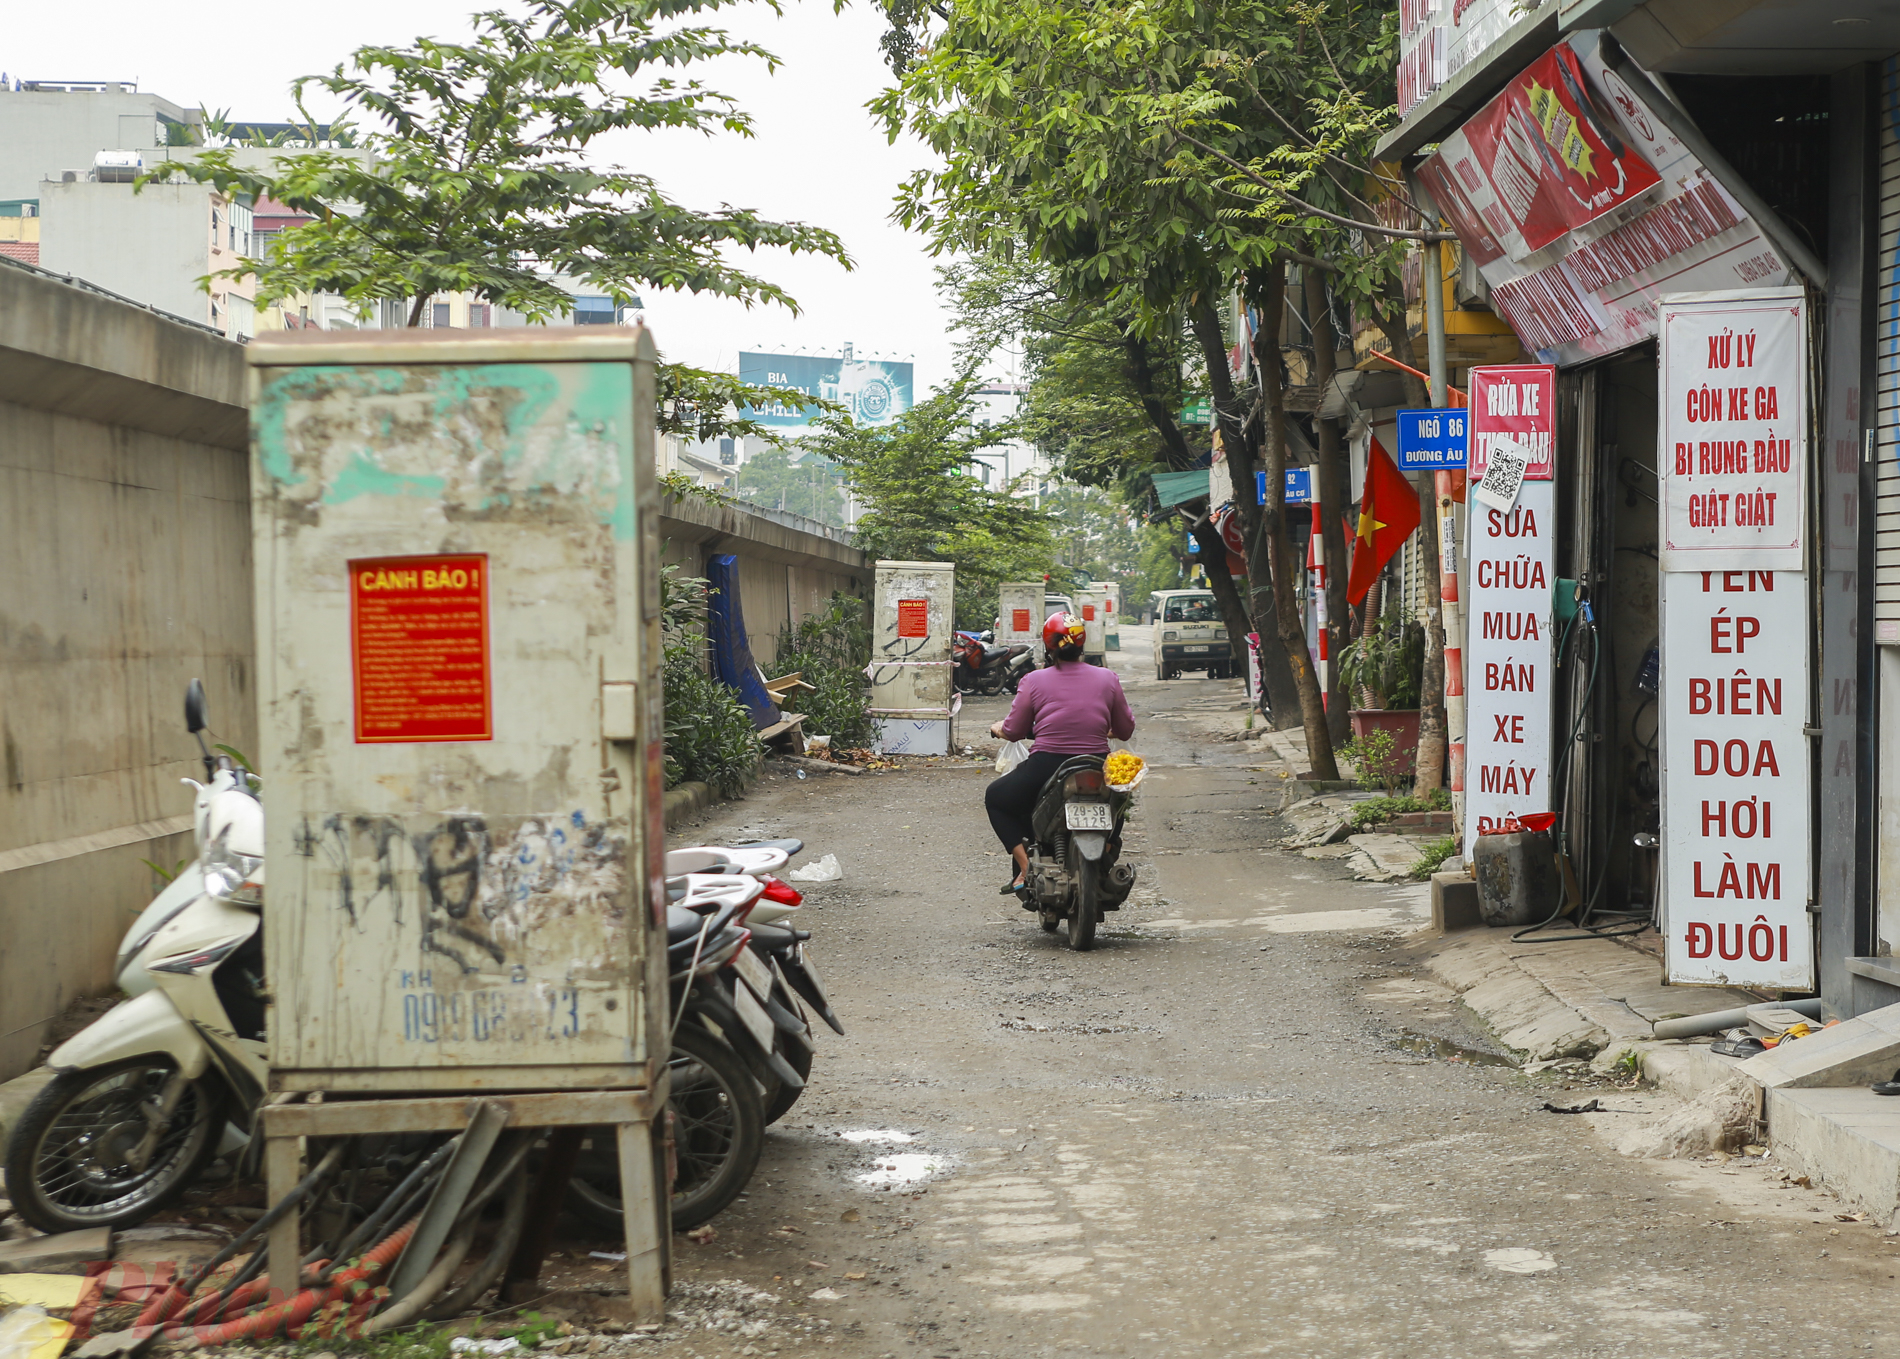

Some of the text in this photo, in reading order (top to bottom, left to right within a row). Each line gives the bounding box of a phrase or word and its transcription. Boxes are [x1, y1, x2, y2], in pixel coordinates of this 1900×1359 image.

[1708, 327, 1756, 369] XỬ LÝ
[768, 372, 788, 384] BIA
[1488, 376, 1540, 417] RỬA XE
[1687, 383, 1779, 423] CÔN XE GA
[1418, 415, 1463, 438] NGÕ 86
[1406, 448, 1443, 462] ĐƯỜNG
[1446, 448, 1463, 461] ÂU
[1676, 428, 1790, 482] BỊ RUNG ĐẦU
[1285, 490, 1295, 498] ÂU
[1287, 473, 1296, 485] 92
[1689, 486, 1777, 534] GIẬT GIẬT
[1478, 555, 1547, 589] CHỮA
[1483, 612, 1540, 641] MUA
[1710, 607, 1760, 654] ÉP
[1485, 657, 1535, 693] BÁN
[1689, 669, 1782, 715] BIÊN
[1493, 715, 1525, 744] XE
[1693, 739, 1780, 777] DOA
[1481, 760, 1536, 796] MÁY
[1072, 805, 1105, 816] 29-S8
[1074, 816, 1107, 828] 1125
[1701, 795, 1771, 838] HƠI
[1693, 852, 1781, 900] LÀM
[1685, 915, 1788, 962] ĐUÔI
